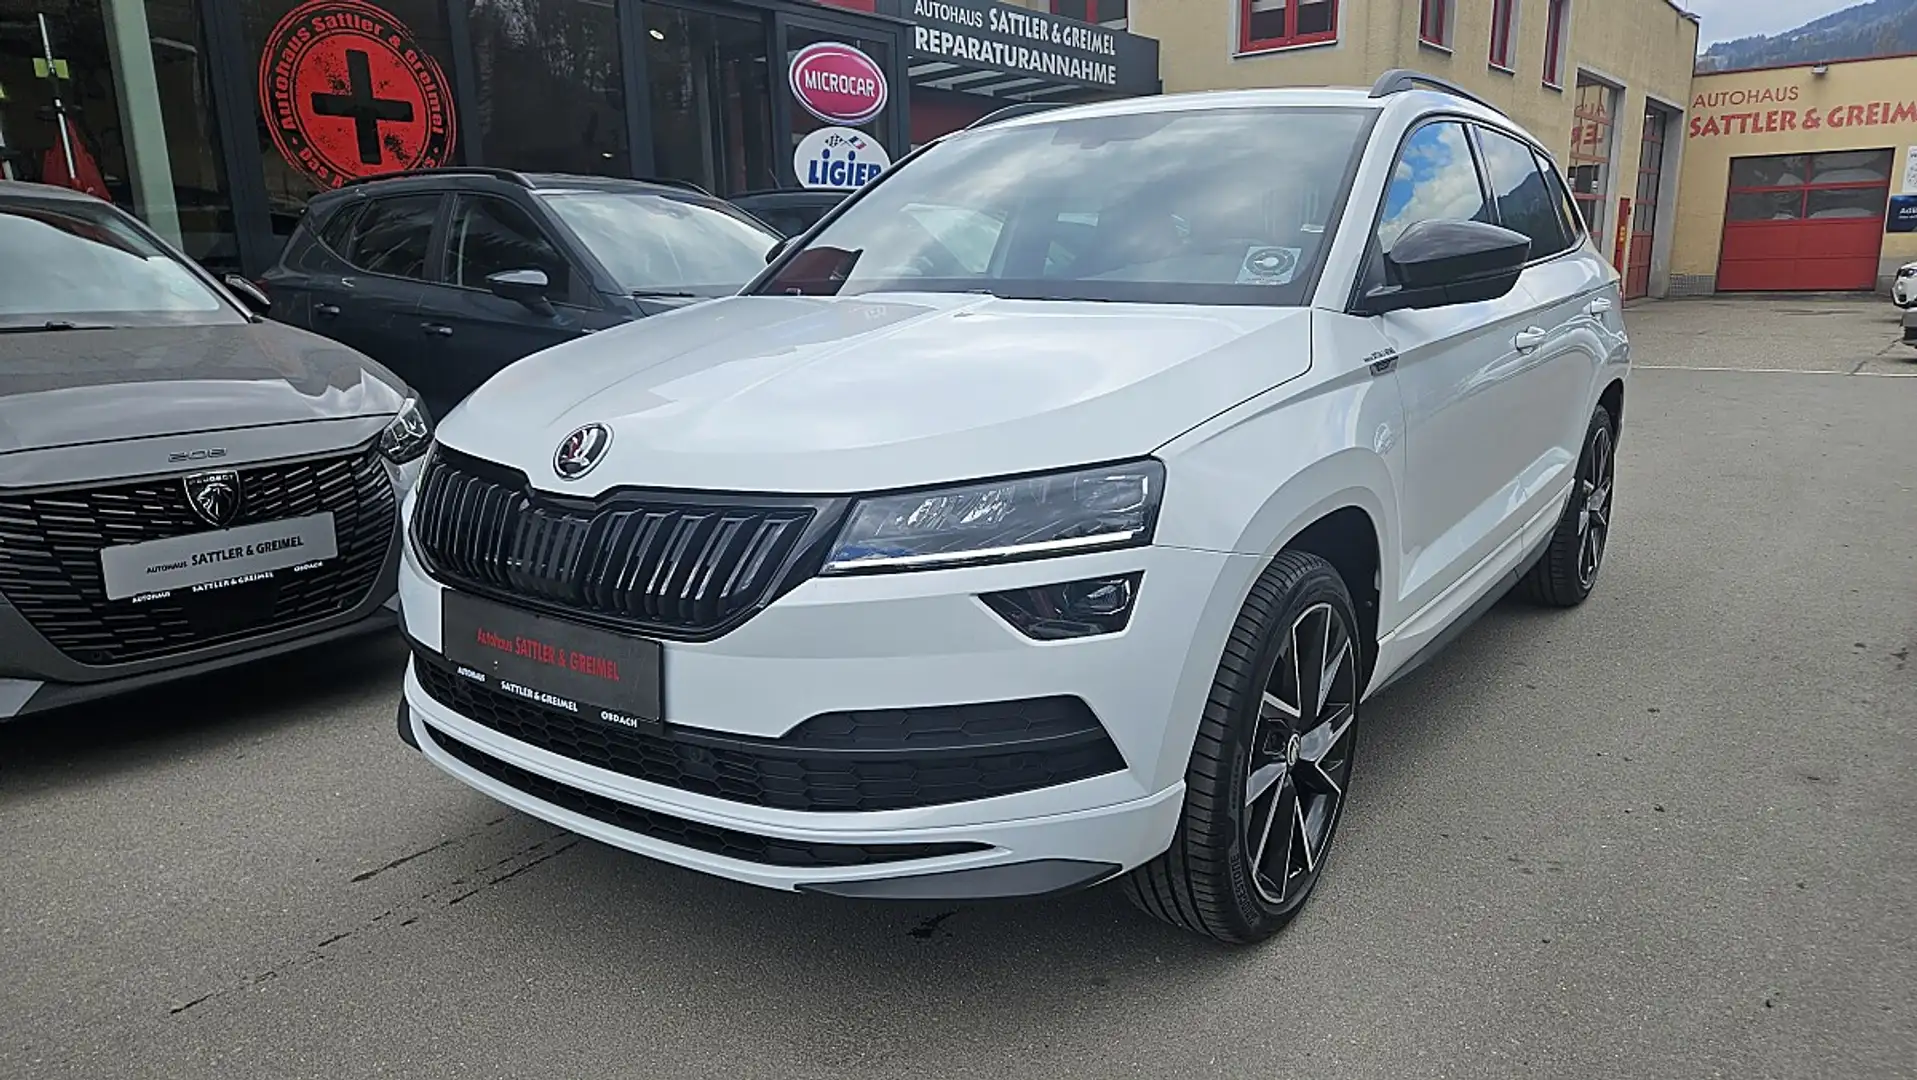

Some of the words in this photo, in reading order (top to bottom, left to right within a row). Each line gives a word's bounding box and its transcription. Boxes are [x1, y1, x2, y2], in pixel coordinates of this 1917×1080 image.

[914, 0, 983, 28] AUTOHAUS
[989, 8, 1049, 42] SATTLER
[1052, 24, 1062, 44] &
[1063, 26, 1116, 56] GREIMEL
[275, 26, 311, 131] Autohaus
[311, 13, 384, 36] Sattler
[403, 49, 445, 135] Greimel
[915, 26, 1117, 85] REPARATURANNAHME
[804, 69, 876, 98] MICROCAR
[1692, 86, 1800, 109] AUTOHAUS
[1689, 110, 1797, 139] SATTLER
[1802, 108, 1821, 130] &
[168, 447, 227, 463] 208
[146, 561, 188, 575] AUTOHAUS
[191, 546, 243, 567] SATTLER
[246, 544, 254, 556] &
[256, 535, 304, 555] GREIMEL
[132, 590, 171, 604] AUTOHAUS
[192, 577, 230, 593] SATTLER
[238, 571, 274, 585] GREIMEL
[515, 635, 555, 664] SATTLER
[557, 650, 566, 666] &
[570, 651, 620, 682] GREIMEL
[456, 666, 486, 682] AUTOHAUS
[501, 680, 534, 699] SATTLER
[541, 691, 579, 713] GREIMEL
[600, 711, 638, 729] OBDACH
